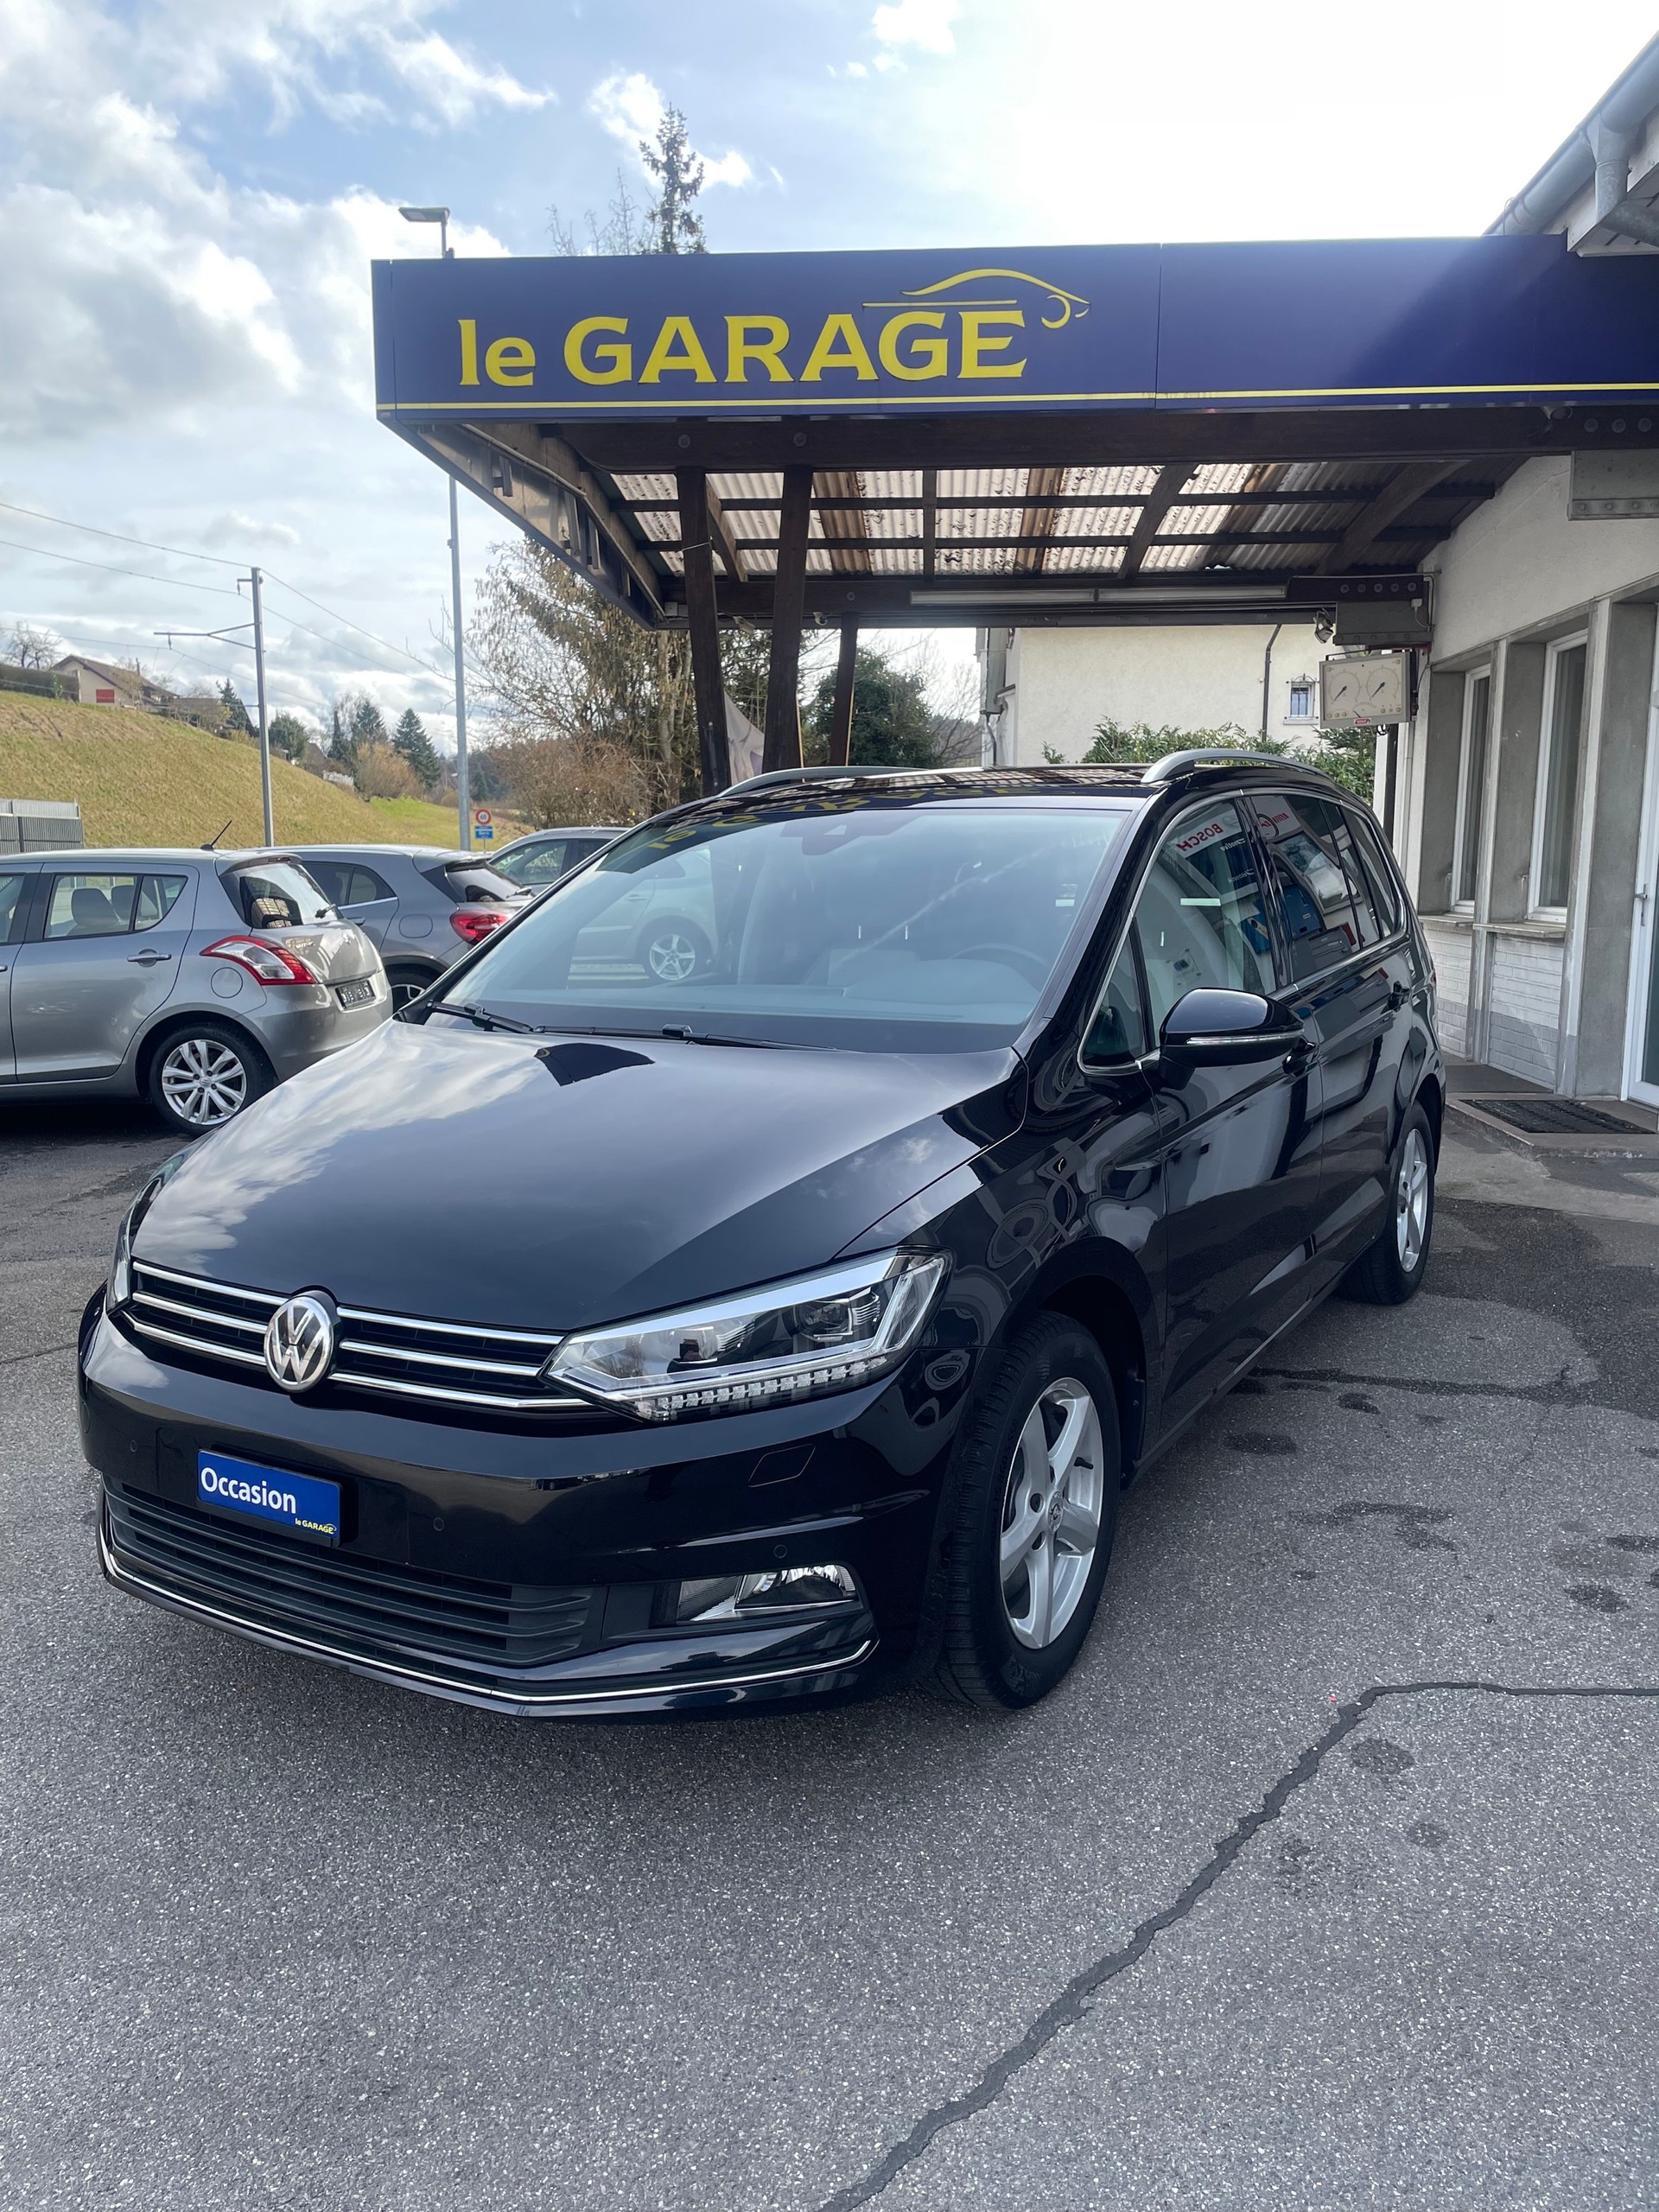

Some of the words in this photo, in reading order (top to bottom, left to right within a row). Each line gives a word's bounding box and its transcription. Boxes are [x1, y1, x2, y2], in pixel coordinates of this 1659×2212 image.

[458, 318, 535, 386] le
[563, 309, 1027, 386] GARAGE
[200, 1467, 296, 1514] Occasion
[302, 1520, 334, 1535] GARAGE
